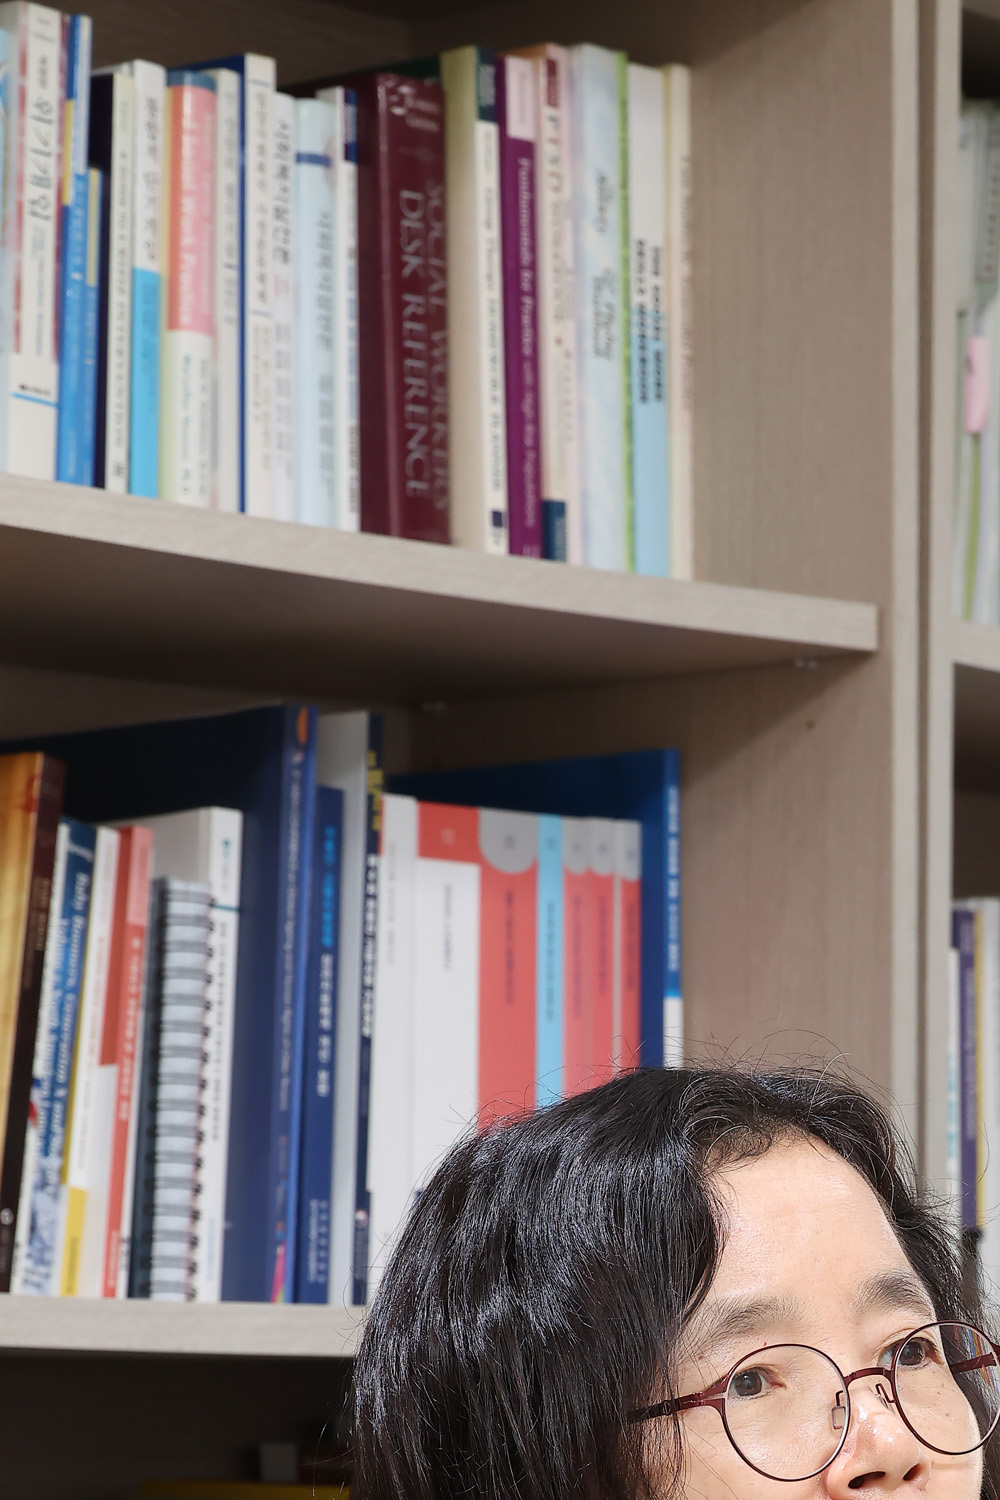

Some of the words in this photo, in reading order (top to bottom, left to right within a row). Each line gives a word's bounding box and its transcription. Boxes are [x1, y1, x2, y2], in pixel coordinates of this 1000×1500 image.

[27, 98, 55, 221] 위기개입
[519, 158, 534, 267] Fundamentals
[399, 189, 427, 279] DESK
[521, 294, 536, 356] Practice
[401, 292, 431, 498] REFERENCE
